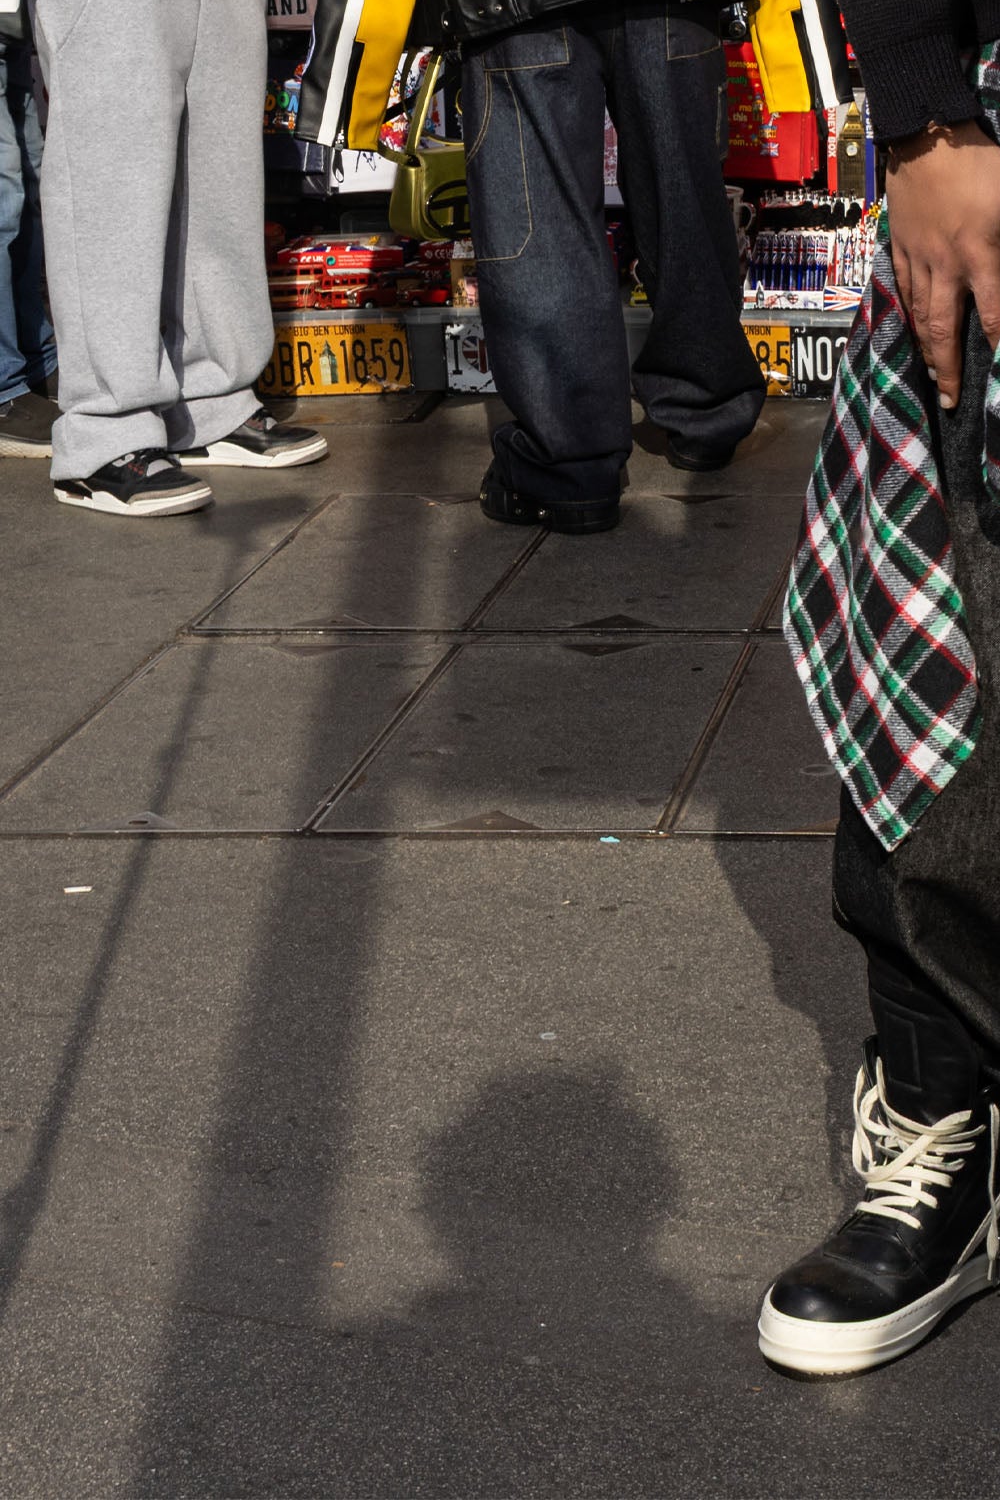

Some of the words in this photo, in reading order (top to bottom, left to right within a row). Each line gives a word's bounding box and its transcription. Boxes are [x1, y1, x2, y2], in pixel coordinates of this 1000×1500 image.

[828, 138, 838, 158] BOX
[294, 325, 309, 338] BIG
[313, 324, 330, 337] BEN
[334, 323, 366, 337] LONDON
[744, 324, 772, 337] ONDON
[339, 339, 405, 384] 1859
